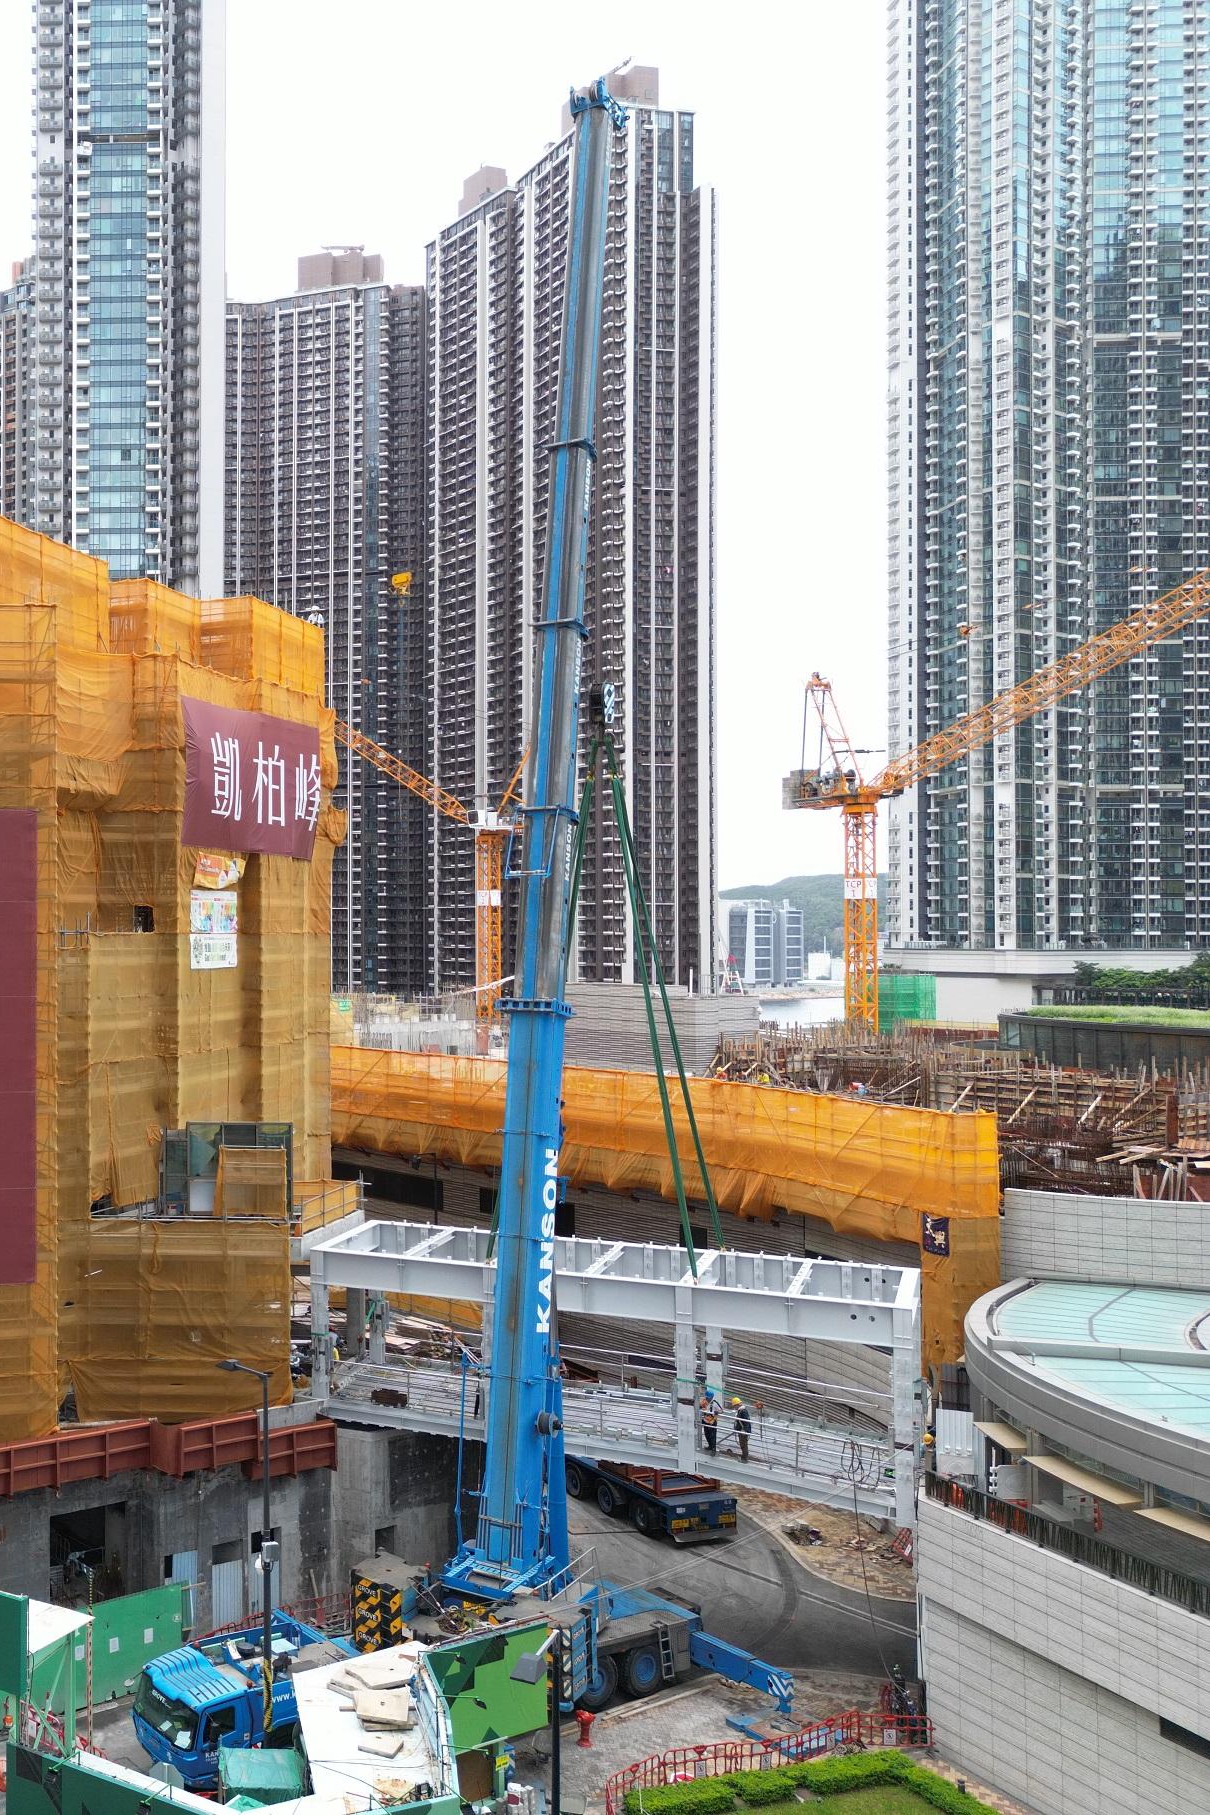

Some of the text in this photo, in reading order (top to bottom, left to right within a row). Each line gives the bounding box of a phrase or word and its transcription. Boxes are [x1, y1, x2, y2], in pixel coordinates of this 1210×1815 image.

[583, 458, 591, 512] KANSON
[574, 638, 582, 694] KANSON
[210, 731, 321, 832] 凱柏峰
[564, 823, 573, 881] KANSON
[535, 1148, 558, 1334] KANSON
[357, 1584, 377, 1598] GROVE
[357, 1607, 378, 1621] GROVE
[358, 1630, 378, 1645] GROVE
